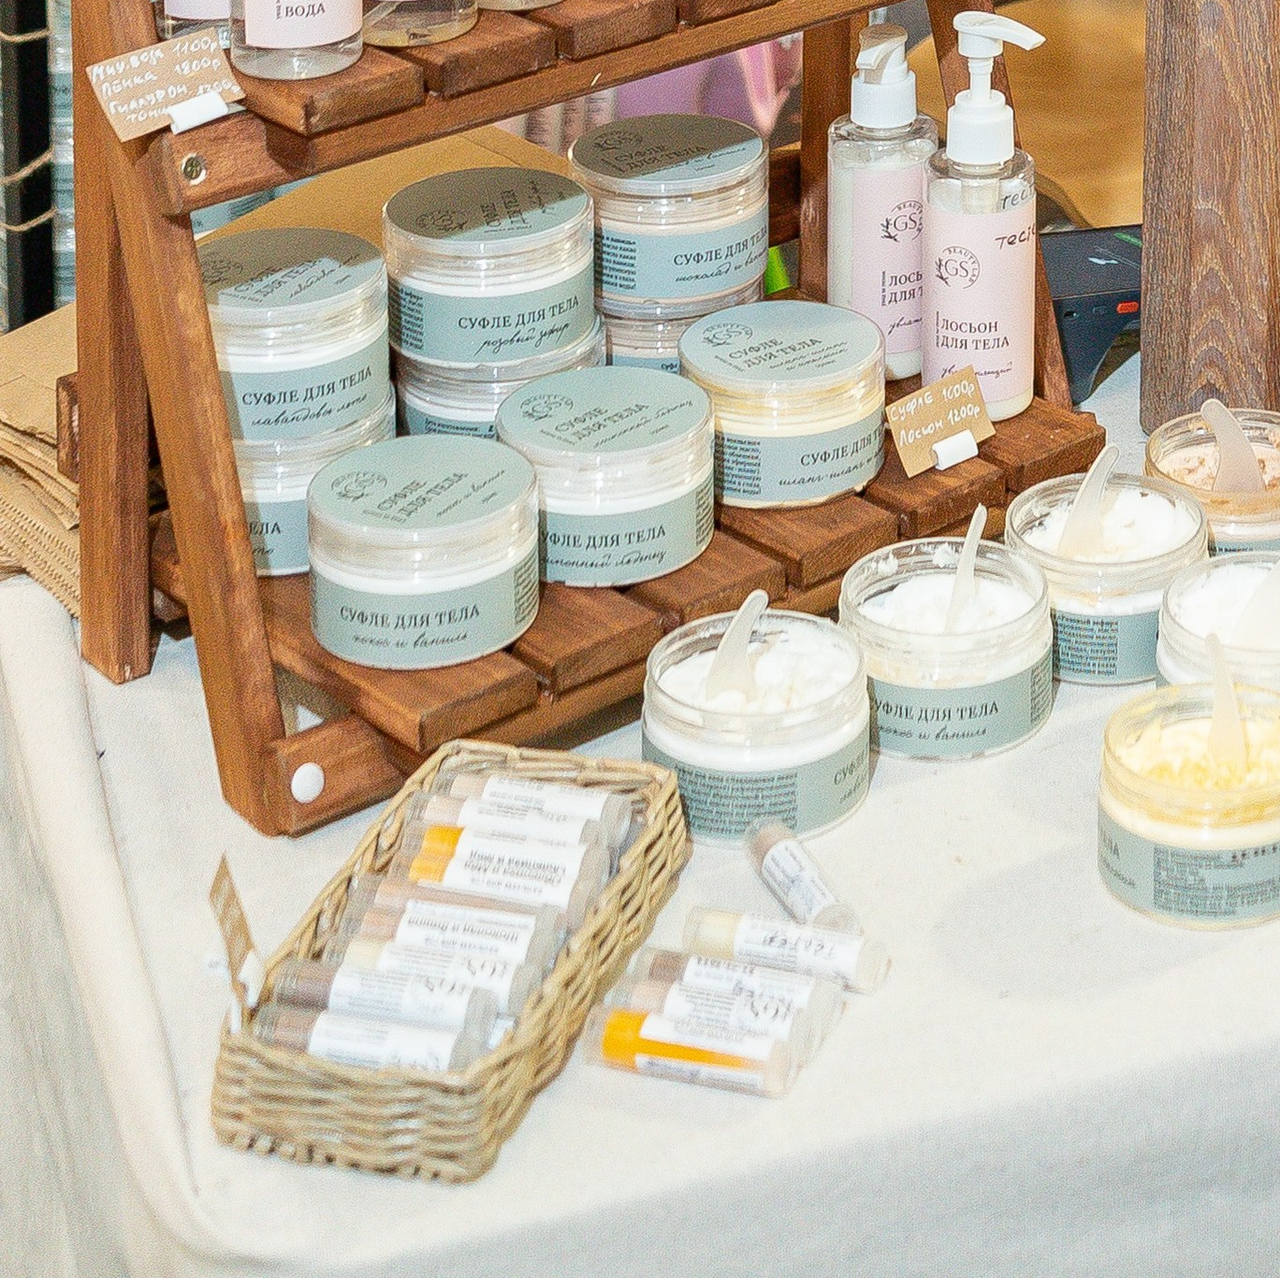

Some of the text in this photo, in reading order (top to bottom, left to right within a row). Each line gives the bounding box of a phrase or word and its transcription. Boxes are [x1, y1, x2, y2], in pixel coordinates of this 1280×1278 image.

[284, 2, 327, 19] ВОДА
[893, 211, 918, 233] GS
[673, 249, 722, 266] СУФЛЕ
[724, 238, 750, 260] ДЛЯ
[888, 269, 923, 287] ЛОСЬ
[944, 258, 970, 279] GS
[887, 289, 917, 306] ДЛЯ
[458, 294, 580, 330] СУФЛЕ ДЛЯ ТЕЛА
[940, 318, 1000, 335] ЛОСЬОН
[940, 334, 1011, 351] ДЛЯ ТЕЛА
[242, 365, 372, 406] СУФЛЕ ДЛЯ ТЕЛА
[800, 435, 873, 467] СУФЛЕ ДЛЯ
[248, 521, 282, 536] ЕЛА
[542, 523, 667, 551] УФЛЕ ДЛЯ ТЕЛА
[340, 603, 481, 631] СУФЛЕ ДЛЯ ТЕЛА
[874, 698, 1000, 724] УФЛЕ ДЛЯ ТЕЛА
